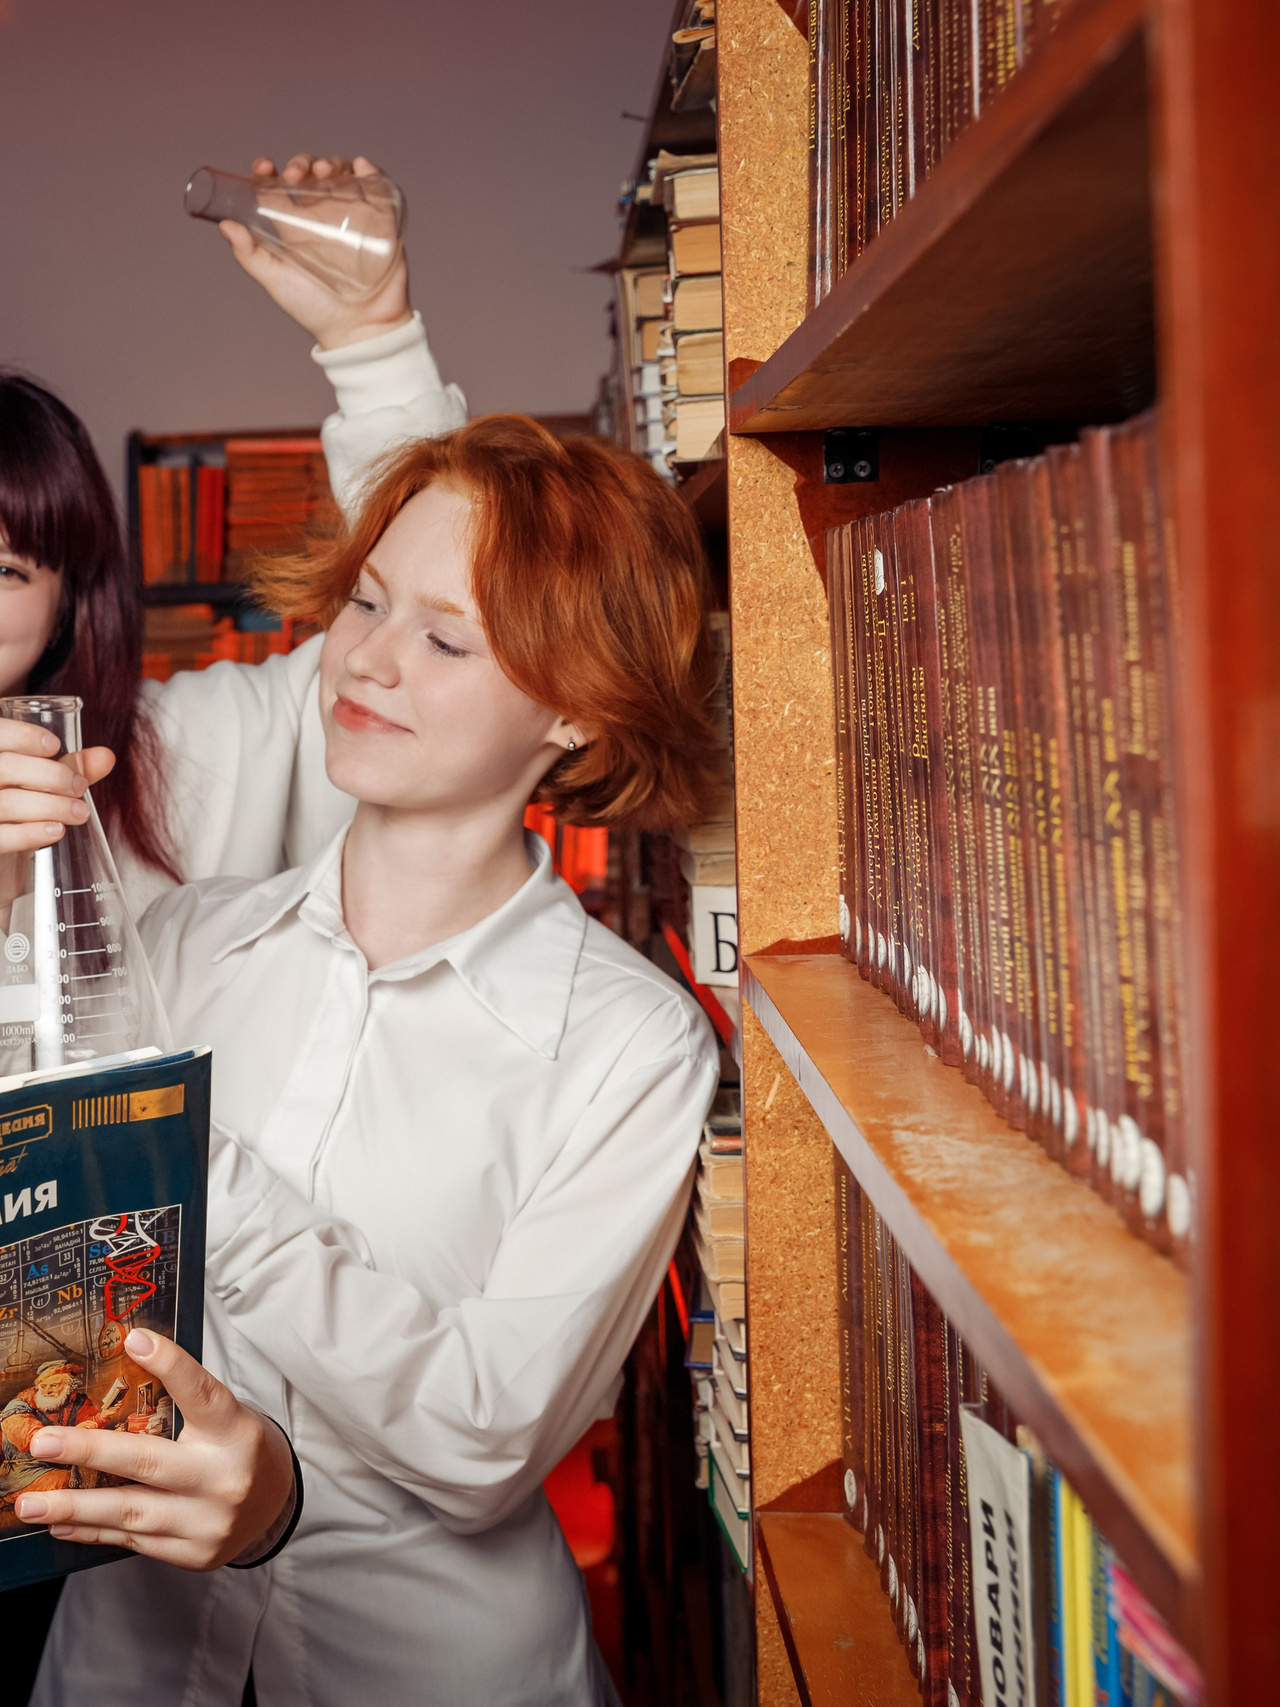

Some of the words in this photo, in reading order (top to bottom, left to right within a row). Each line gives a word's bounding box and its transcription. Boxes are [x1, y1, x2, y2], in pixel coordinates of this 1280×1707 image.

[809, 0, 817, 63] Рассказ
[708, 911, 738, 973] Б
[1, 1024, 35, 1037] 1000ml
[63, 1253, 71, 1261] 33
[89, 1242, 112, 1259] Se
[0, 1272, 7, 1281] 32
[26, 1264, 49, 1281] As
[57, 1284, 83, 1305] Nb
